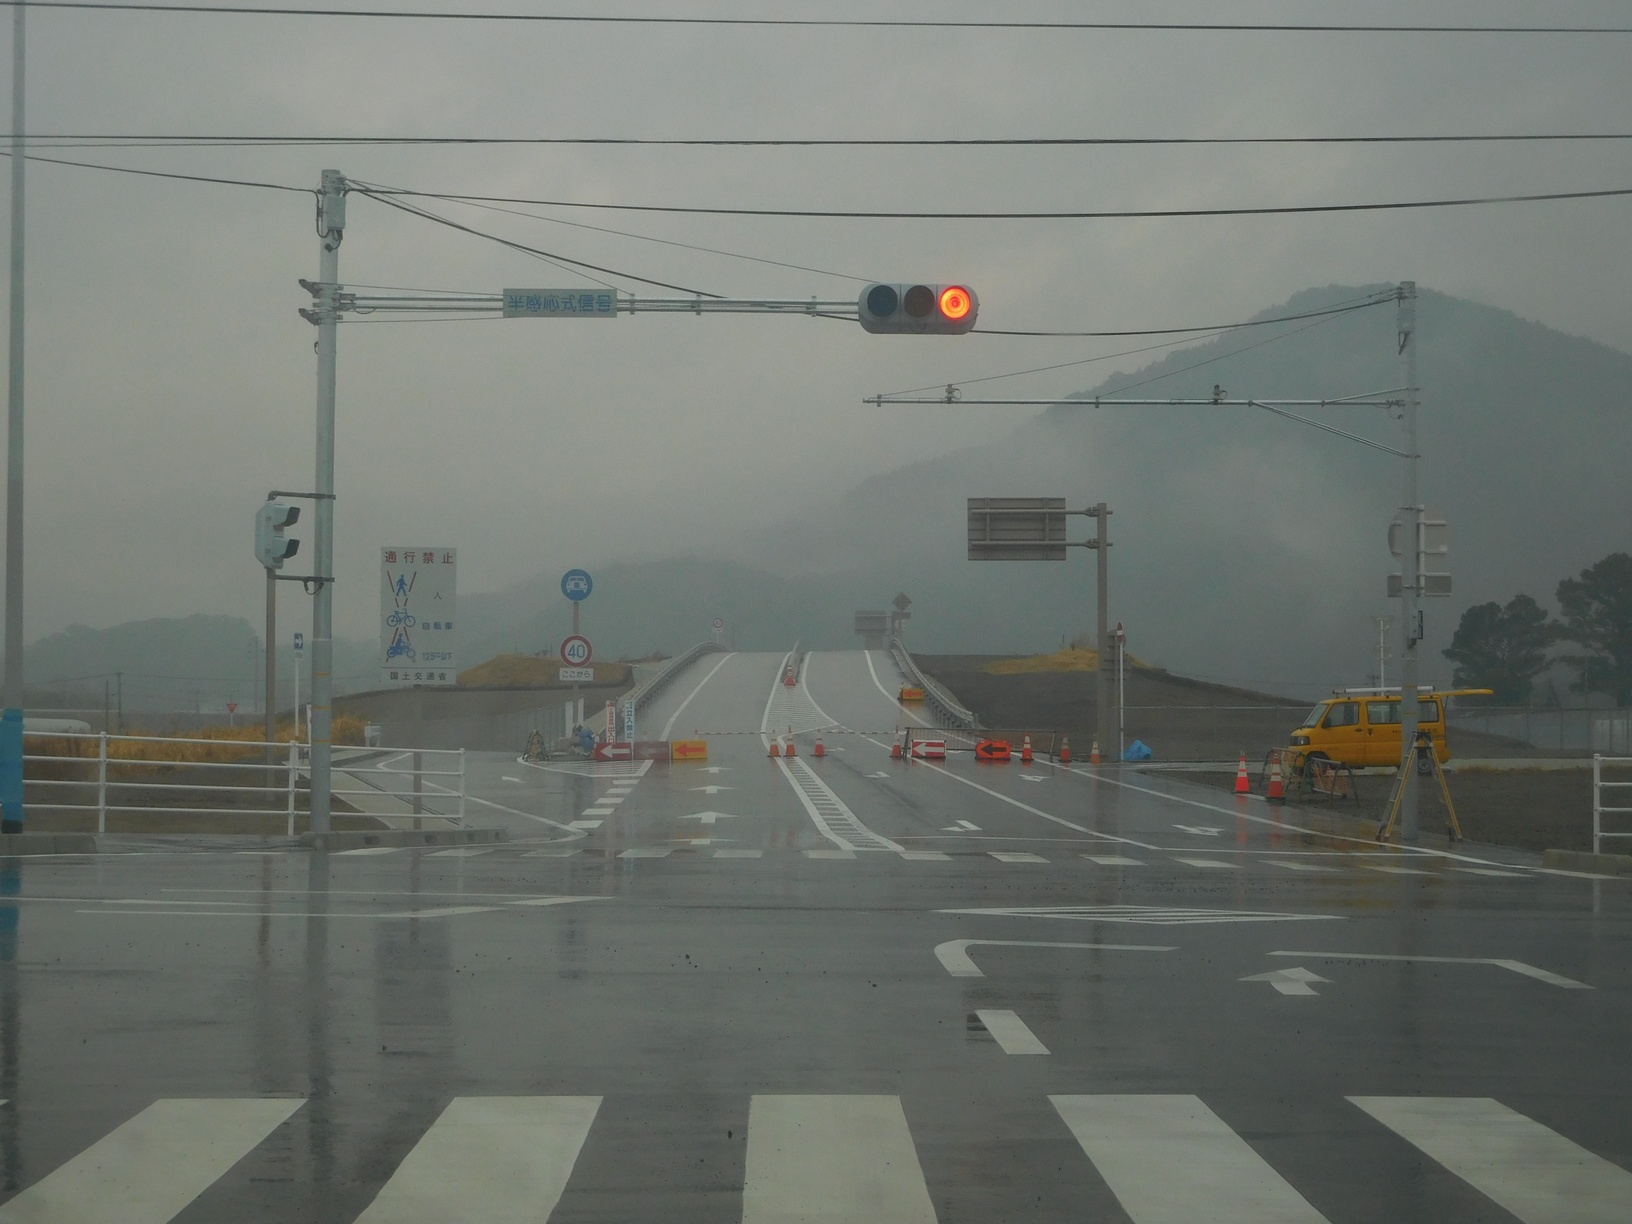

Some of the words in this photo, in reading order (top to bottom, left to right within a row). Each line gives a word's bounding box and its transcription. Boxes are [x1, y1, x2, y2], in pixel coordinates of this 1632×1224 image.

[384, 551, 454, 564] 通行禁止
[433, 591, 442, 600] 人
[422, 621, 453, 630] 自転車
[567, 644, 586, 659] 40
[390, 671, 447, 681] 国土交通省
[562, 670, 591, 678] ここから
